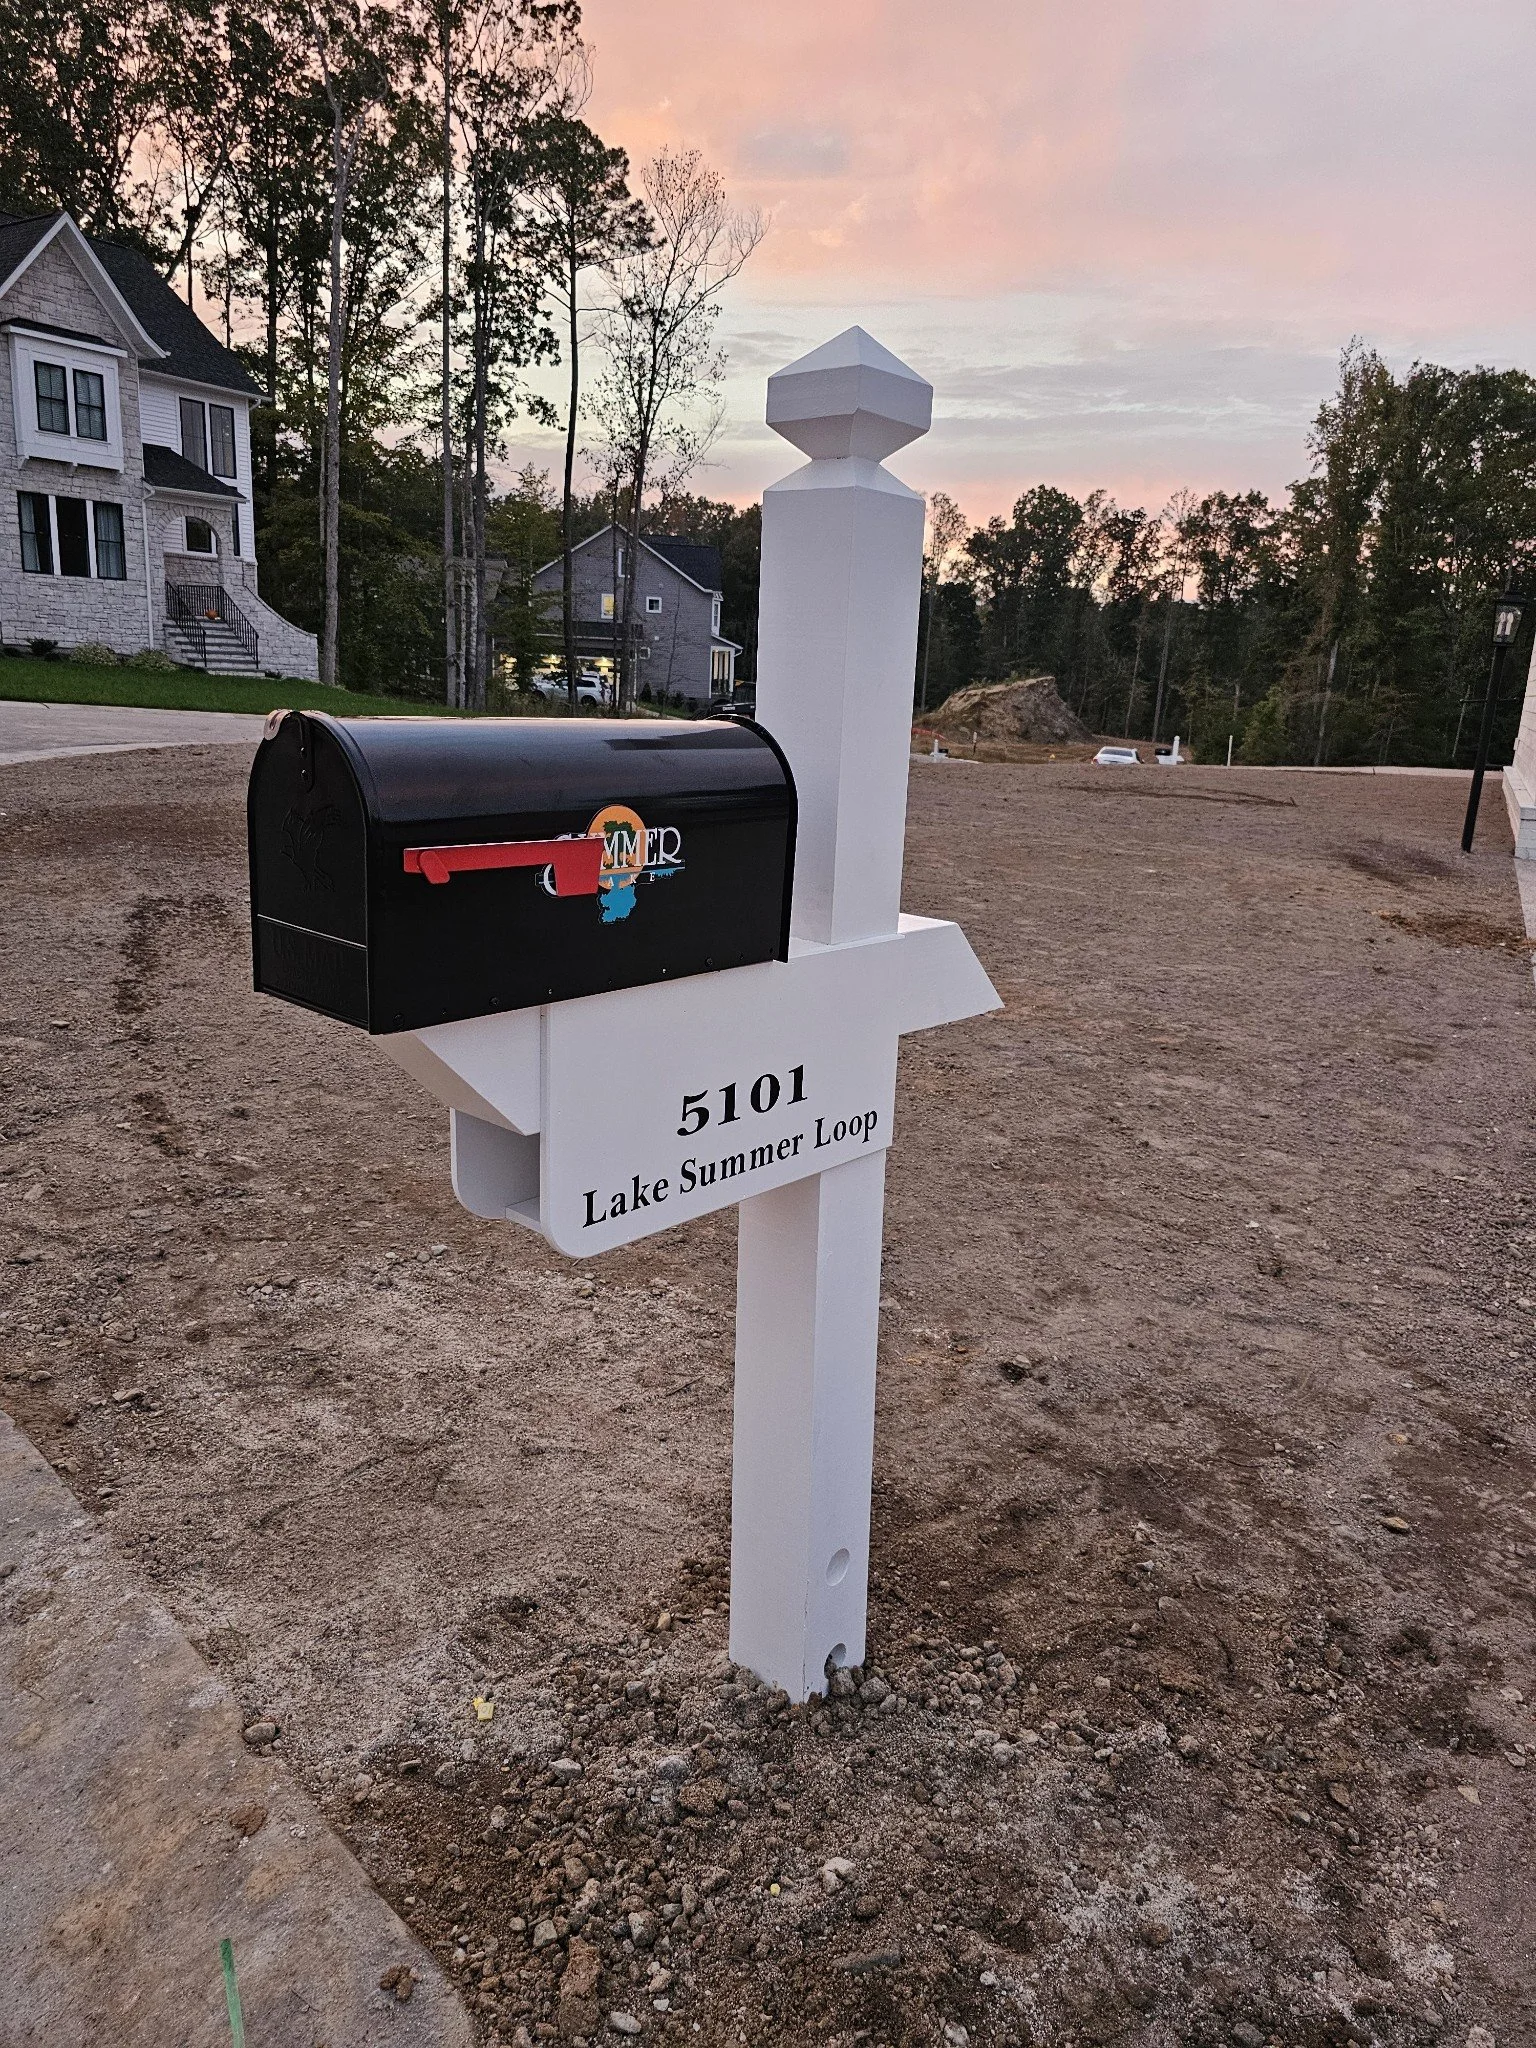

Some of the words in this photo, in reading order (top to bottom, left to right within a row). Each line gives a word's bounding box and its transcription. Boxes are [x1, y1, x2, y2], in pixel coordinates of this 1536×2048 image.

[547, 827, 682, 878] MMER
[606, 871, 656, 887] AKE
[676, 1064, 808, 1136] 5101
[582, 1174, 669, 1228] Lake
[679, 1133, 804, 1195] Summer
[813, 1109, 878, 1149] Loop
